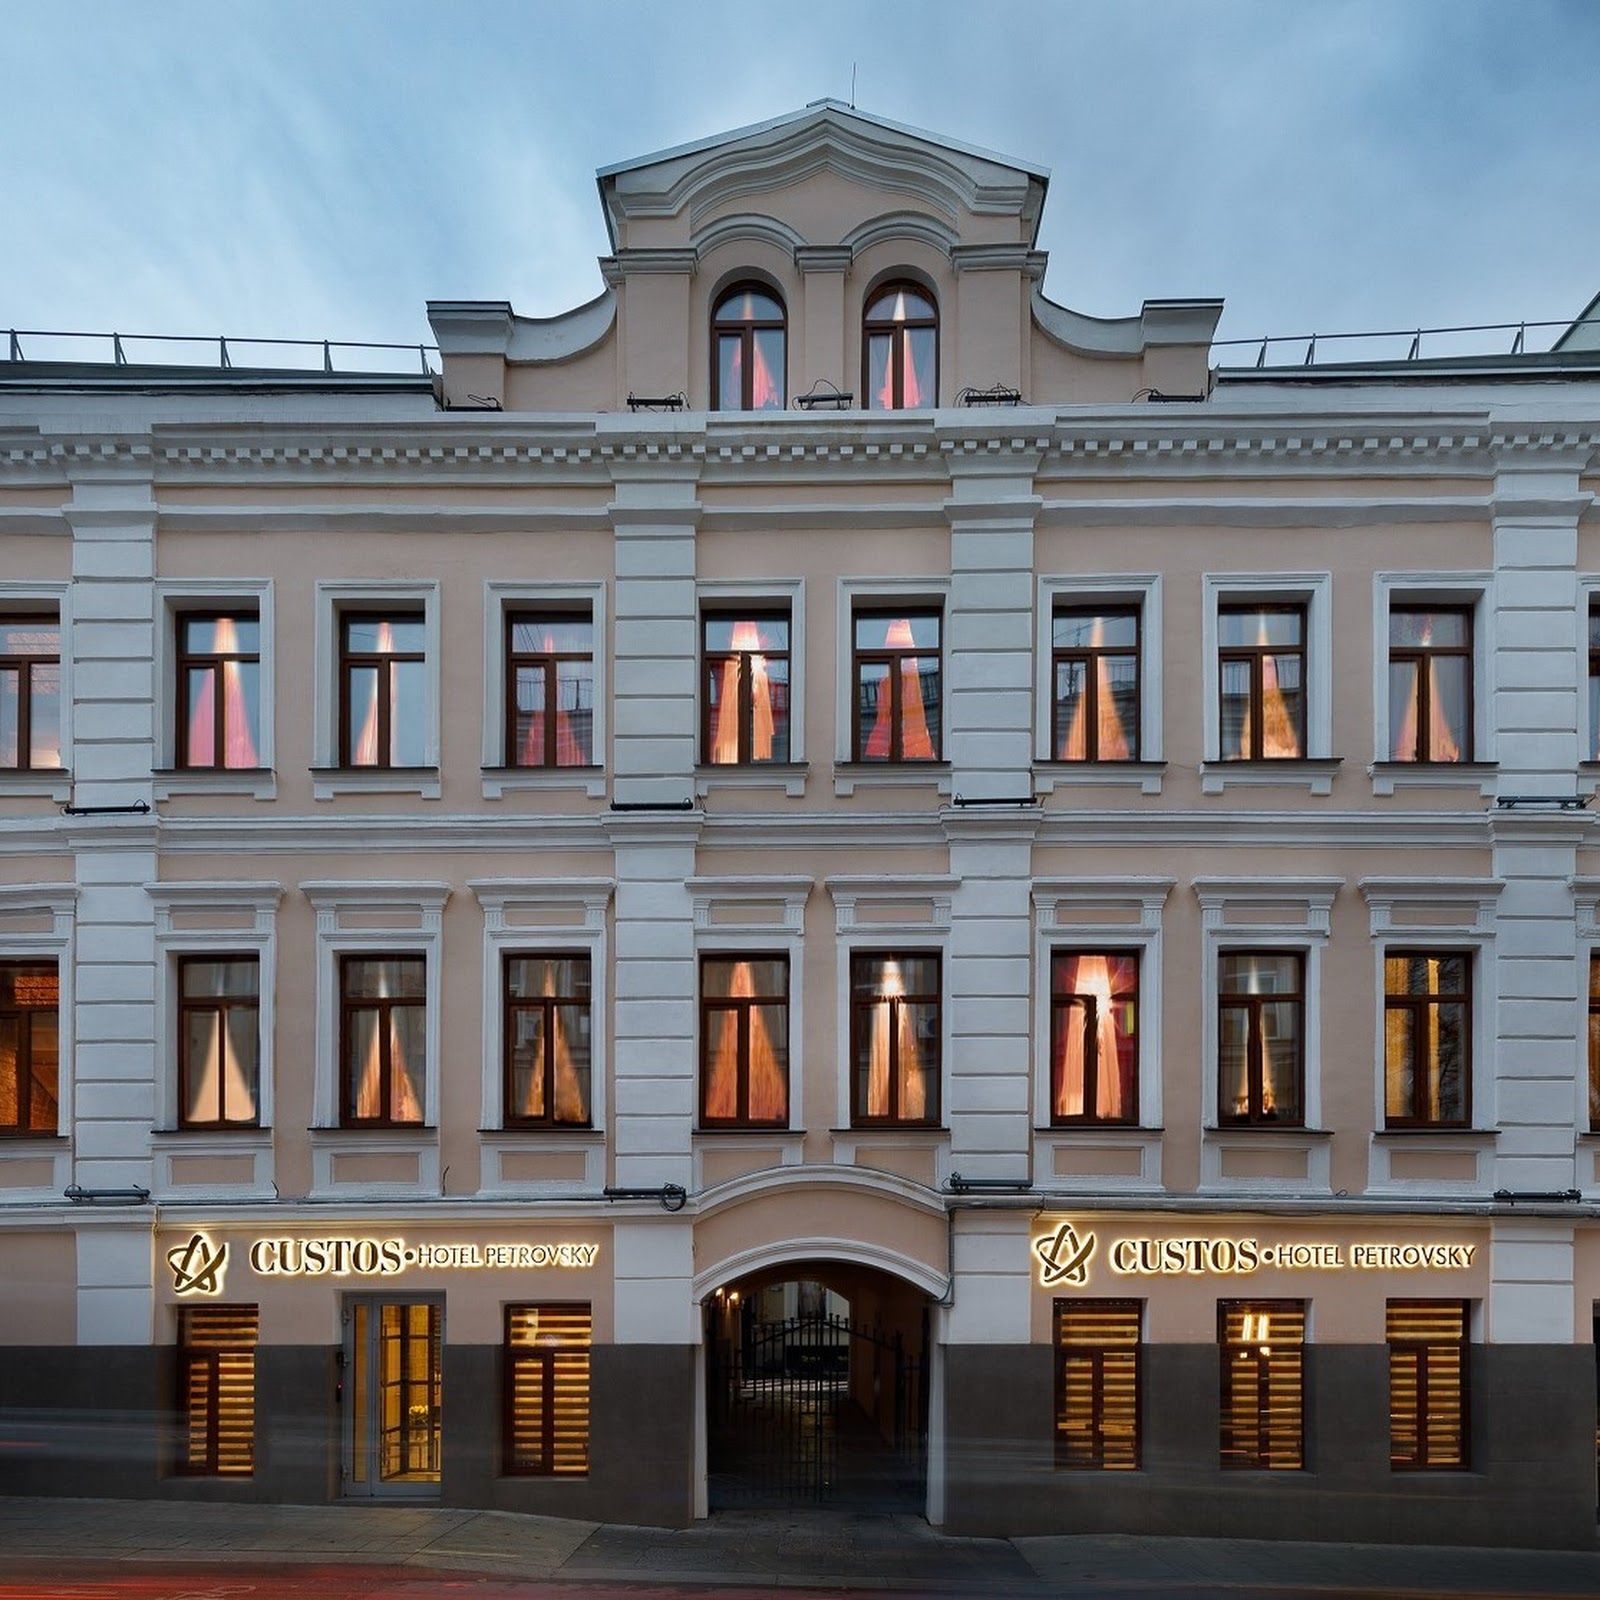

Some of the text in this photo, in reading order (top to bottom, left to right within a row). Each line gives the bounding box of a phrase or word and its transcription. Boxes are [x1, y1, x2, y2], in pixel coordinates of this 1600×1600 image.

[250, 1240, 596, 1273] CUSTOS HOTEL PETROVSKY
[1113, 1240, 1476, 1271] CUSTOS HOTEL PETROVSKY
